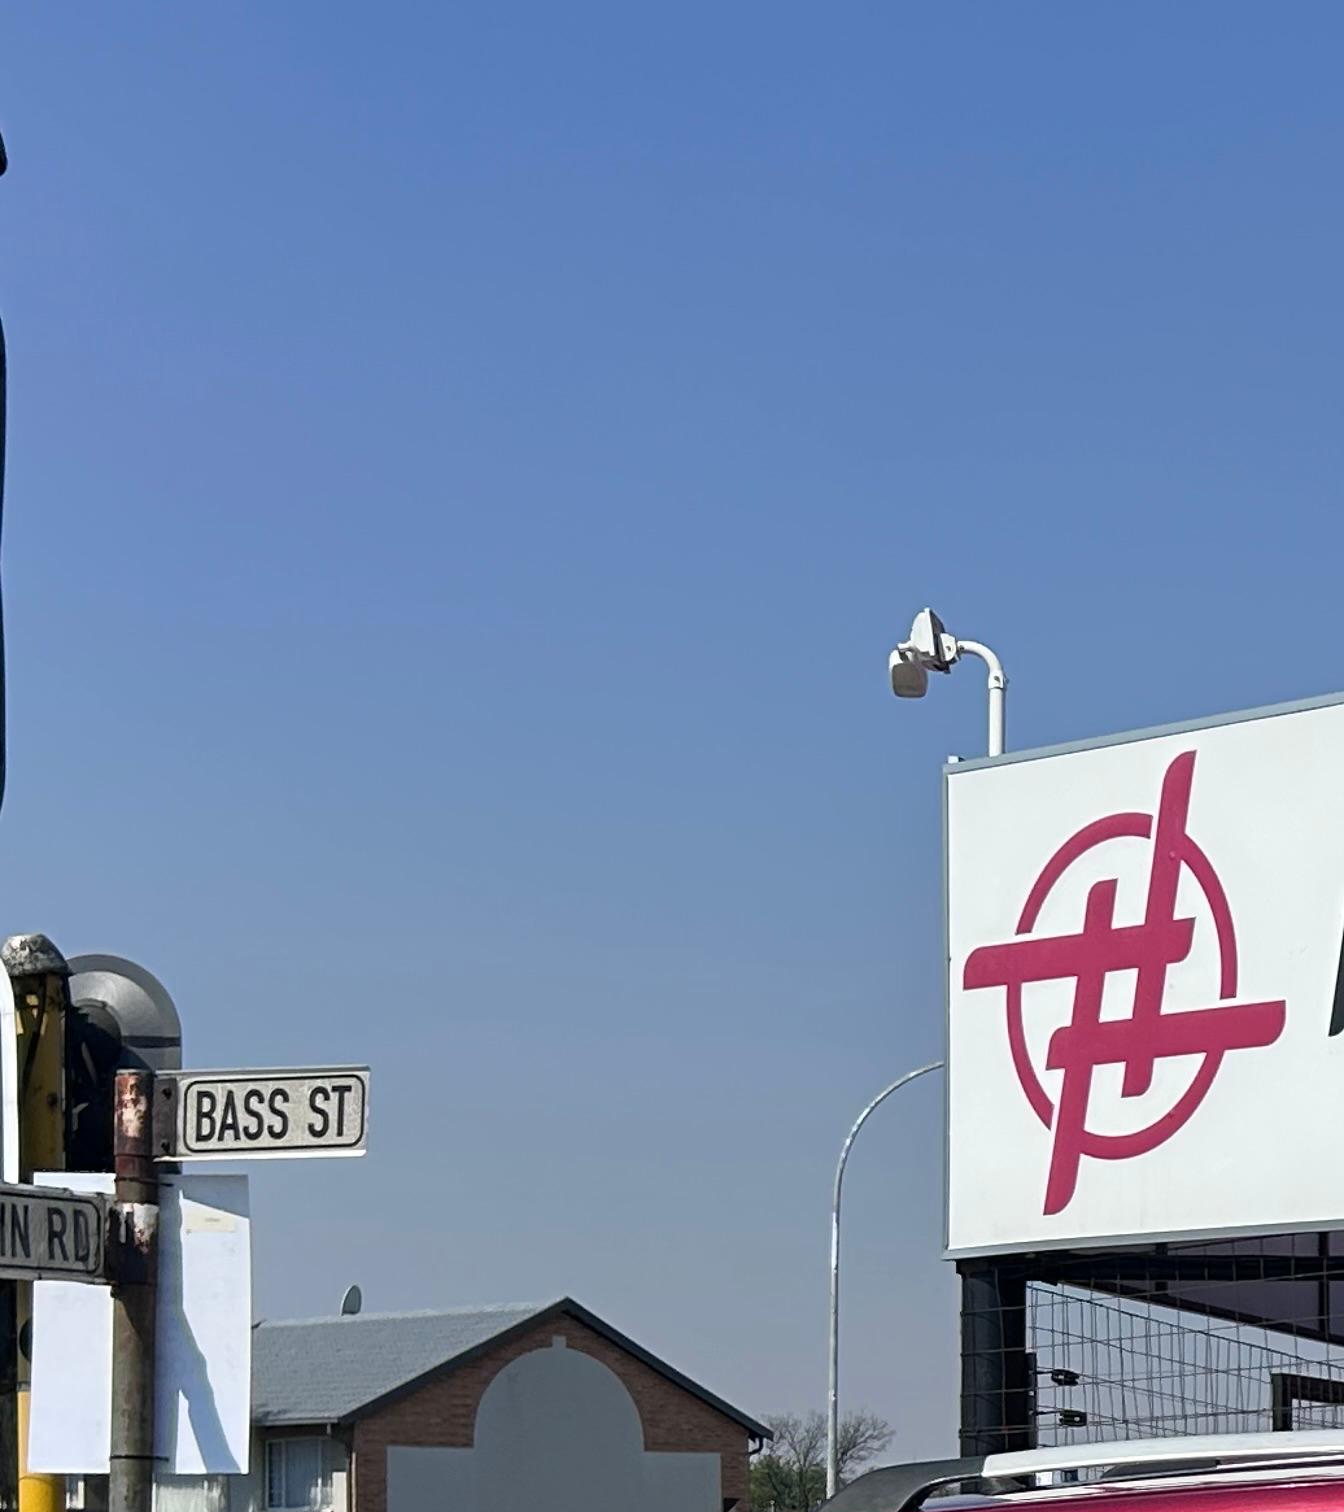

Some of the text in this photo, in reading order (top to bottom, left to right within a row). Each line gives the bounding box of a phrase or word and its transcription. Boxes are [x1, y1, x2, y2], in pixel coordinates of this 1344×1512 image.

[195, 1084, 353, 1143] BASS ST
[47, 1206, 90, 1262] RD
